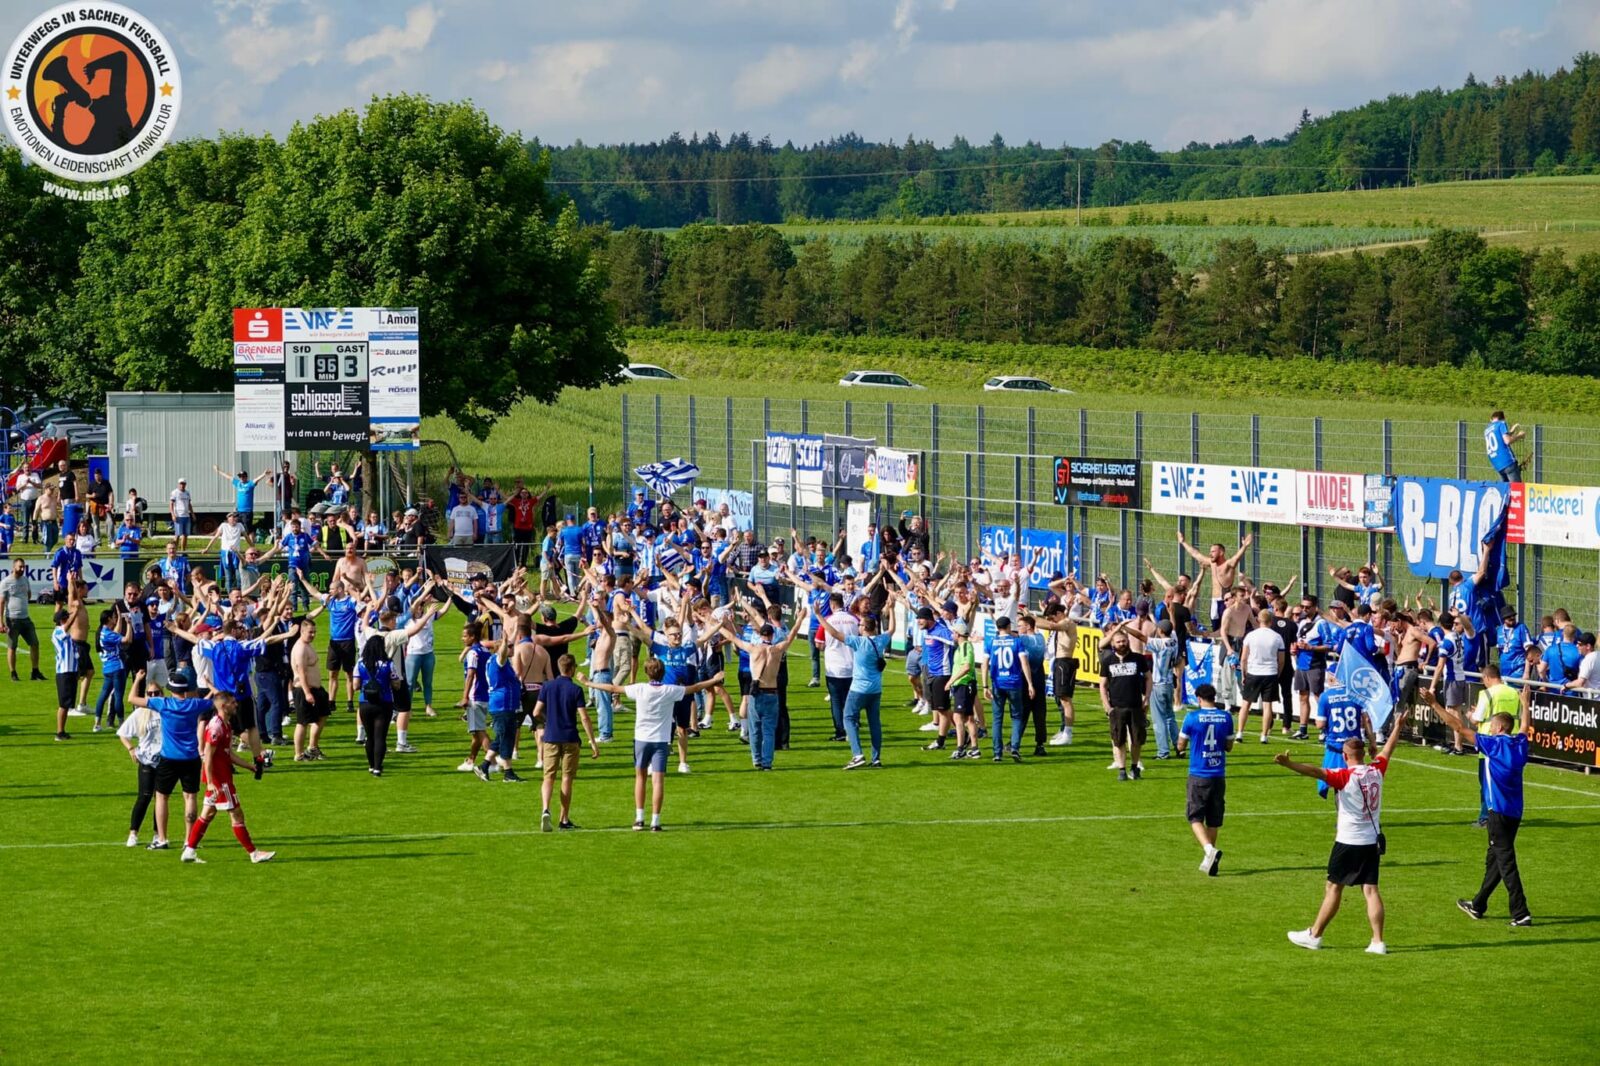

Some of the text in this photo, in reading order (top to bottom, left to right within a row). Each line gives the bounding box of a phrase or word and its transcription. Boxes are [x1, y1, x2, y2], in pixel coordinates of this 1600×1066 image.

[387, 314, 417, 325] Amon
[238, 346, 282, 354] BRENNER
[292, 345, 311, 353] SfD
[336, 345, 365, 353] GAST
[317, 358, 337, 372] 96
[344, 355, 358, 377] 3
[291, 384, 352, 411] schiessel
[287, 429, 369, 442] widmann bewegt.
[1307, 475, 1354, 511] LINDEL
[1529, 487, 1584, 516] Bäckerei
[994, 647, 1013, 669] 10
[1331, 706, 1357, 733] 58
[1528, 700, 1598, 728] Harald Drabek
[1204, 724, 1217, 751] 4
